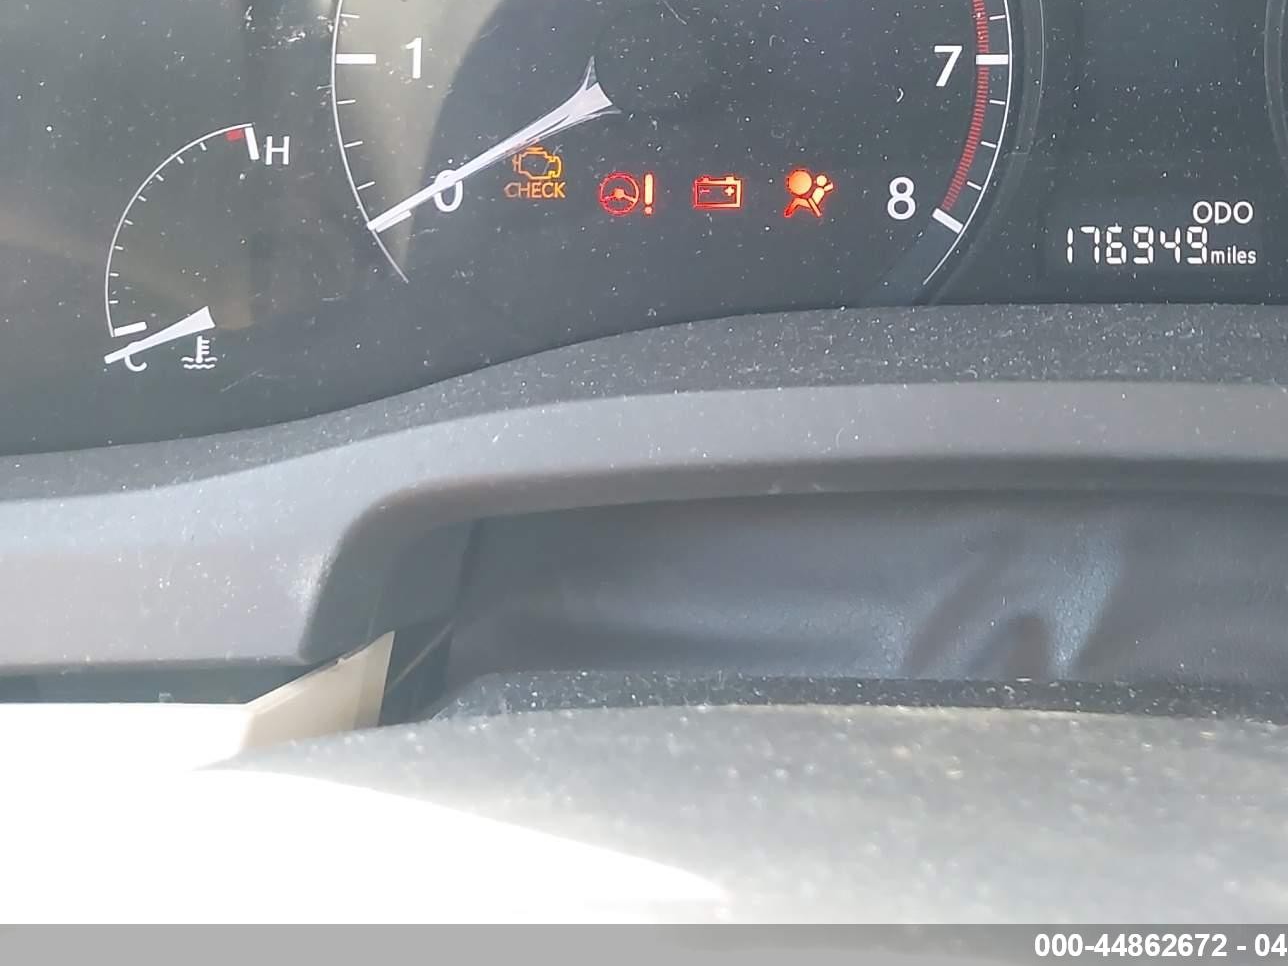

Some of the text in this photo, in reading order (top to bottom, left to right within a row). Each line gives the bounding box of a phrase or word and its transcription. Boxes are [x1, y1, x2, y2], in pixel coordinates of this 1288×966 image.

[405, 38, 422, 79] 1
[934, 46, 960, 87] 7
[265, 135, 290, 165] H
[505, 181, 566, 200] CHECK
[887, 178, 916, 219] 8
[1193, 201, 1254, 224] ODO
[1066, 226, 1257, 265] 176949 miles
